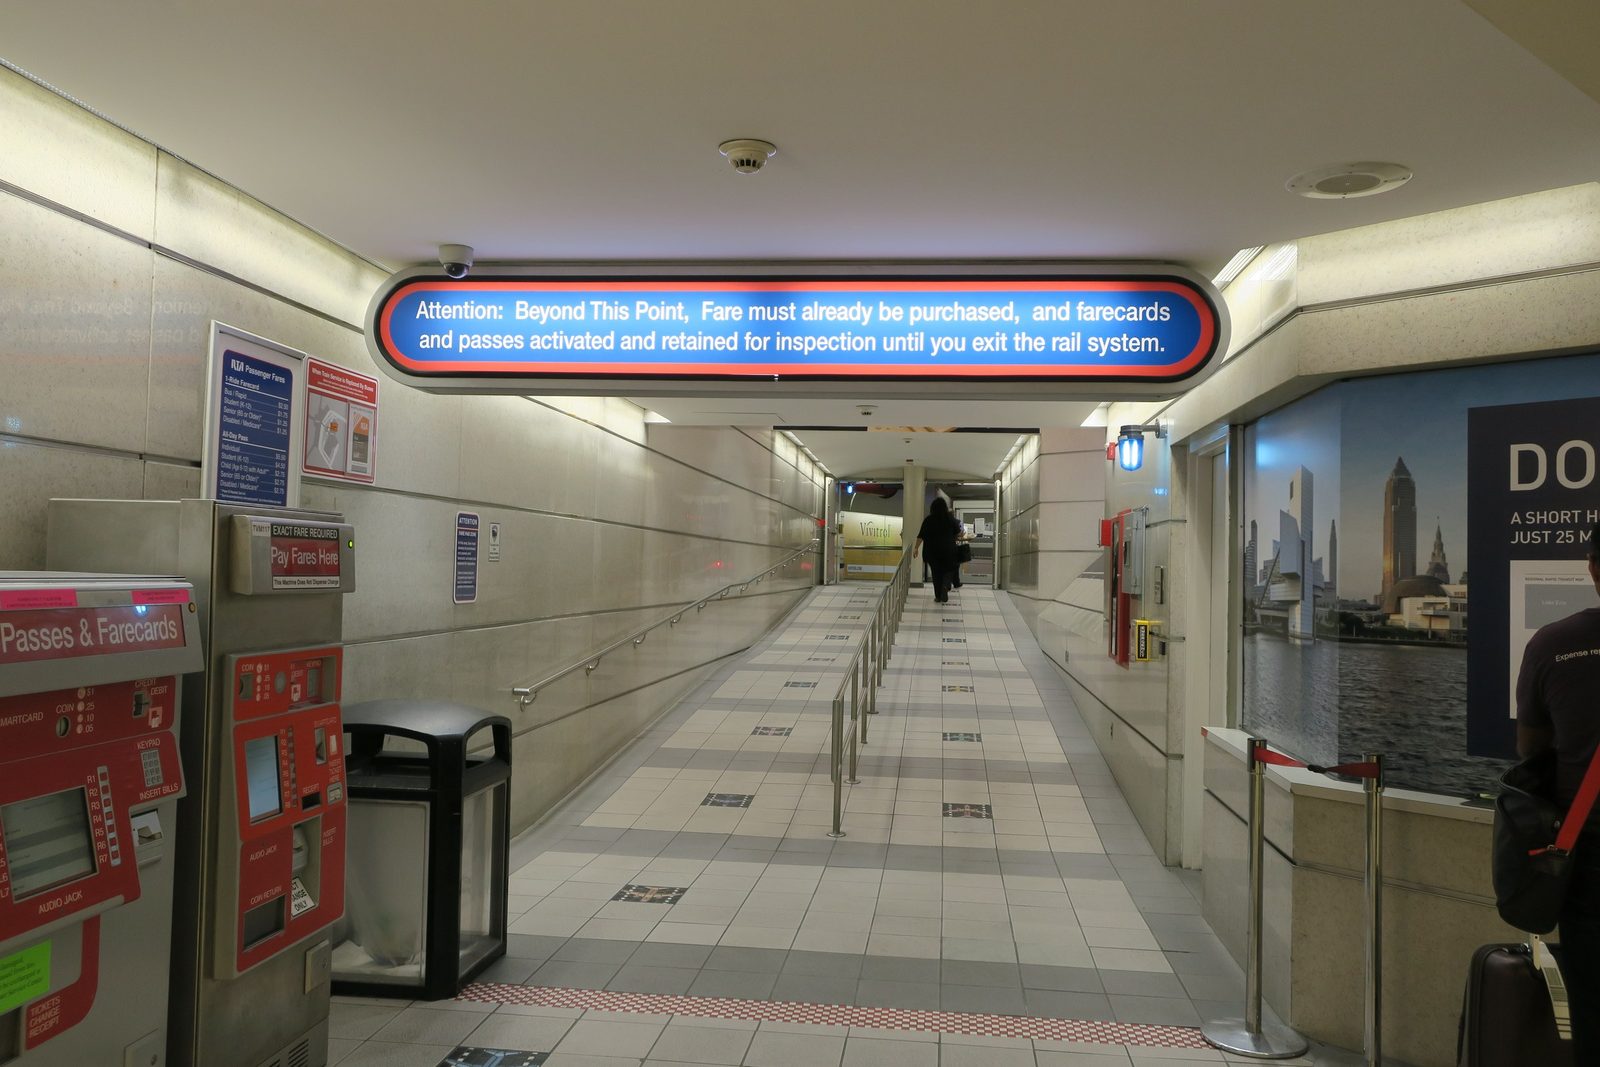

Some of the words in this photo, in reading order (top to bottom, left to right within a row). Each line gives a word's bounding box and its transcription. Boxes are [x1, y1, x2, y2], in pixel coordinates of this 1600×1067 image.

[416, 300, 503, 320] Attention:
[516, 301, 585, 324] Beyond
[590, 301, 630, 320] This
[636, 301, 690, 324] Point,
[702, 301, 743, 320] Fare
[749, 303, 796, 320] must
[802, 302, 873, 326] already
[879, 302, 904, 320] be
[909, 302, 1020, 326] purchased,
[1032, 302, 1070, 321] and
[1076, 301, 1170, 322] farecards
[420, 330, 452, 349] and
[459, 333, 524, 352] passes
[530, 331, 614, 350] activated
[620, 332, 656, 350] and
[662, 332, 738, 350] retained
[744, 332, 770, 350] for
[776, 332, 876, 356] inspection
[883, 332, 924, 351] until
[930, 335, 966, 356] you
[972, 332, 1007, 352] exit
[1013, 332, 1045, 352] the
[1052, 332, 1081, 352] rail
[1088, 334, 1166, 357] system.
[231, 359, 244, 372] RTA
[246, 364, 271, 380] Passenger
[272, 373, 286, 384] Fares
[240, 380, 260, 390] Farecard
[224, 388, 232, 396] Bus
[235, 390, 248, 400] Rapid
[224, 396, 240, 406] Student
[224, 406, 236, 414] Senior
[223, 415, 240, 425] Disabled
[222, 431, 238, 440] All-Day
[221, 452, 236, 460] Student
[1510, 440, 1596, 491] DO
[1510, 512, 1522, 524] A
[1526, 510, 1582, 524] SHORT
[273, 525, 293, 536] EXACT
[294, 526, 308, 537] FARE
[310, 528, 337, 539] REQUIRED
[860, 521, 891, 538] Vivitrol
[1510, 531, 1551, 544] JUST
[1556, 530, 1574, 544] 25
[271, 546, 289, 568] Pay
[292, 547, 316, 565] Fares
[319, 549, 338, 565] Here
[0, 622, 74, 653] Passes
[80, 618, 94, 647] &
[97, 614, 178, 645] Farecards
[1556, 650, 1588, 662] Expense
[150, 686, 168, 695] DEBIT
[56, 704, 75, 714] COIN
[137, 738, 160, 750] KEYPAD
[87, 776, 96, 784] R1
[89, 788, 98, 797] R2
[140, 787, 161, 800] INSERT
[162, 783, 179, 794] BILLS
[91, 801, 100, 810] R3
[93, 815, 102, 824] R4
[95, 828, 104, 838] R5
[97, 840, 107, 850] R6
[99, 854, 108, 863] R7
[250, 850, 265, 862] AUDIO
[250, 895, 263, 904] COIN
[263, 886, 282, 898] RETURN
[39, 898, 62, 914] AUDIO
[64, 891, 83, 904] JACK
[31, 995, 60, 1016] TICKETS
[31, 1005, 60, 1027] CHANGE
[30, 1015, 59, 1038] RECEIPT
